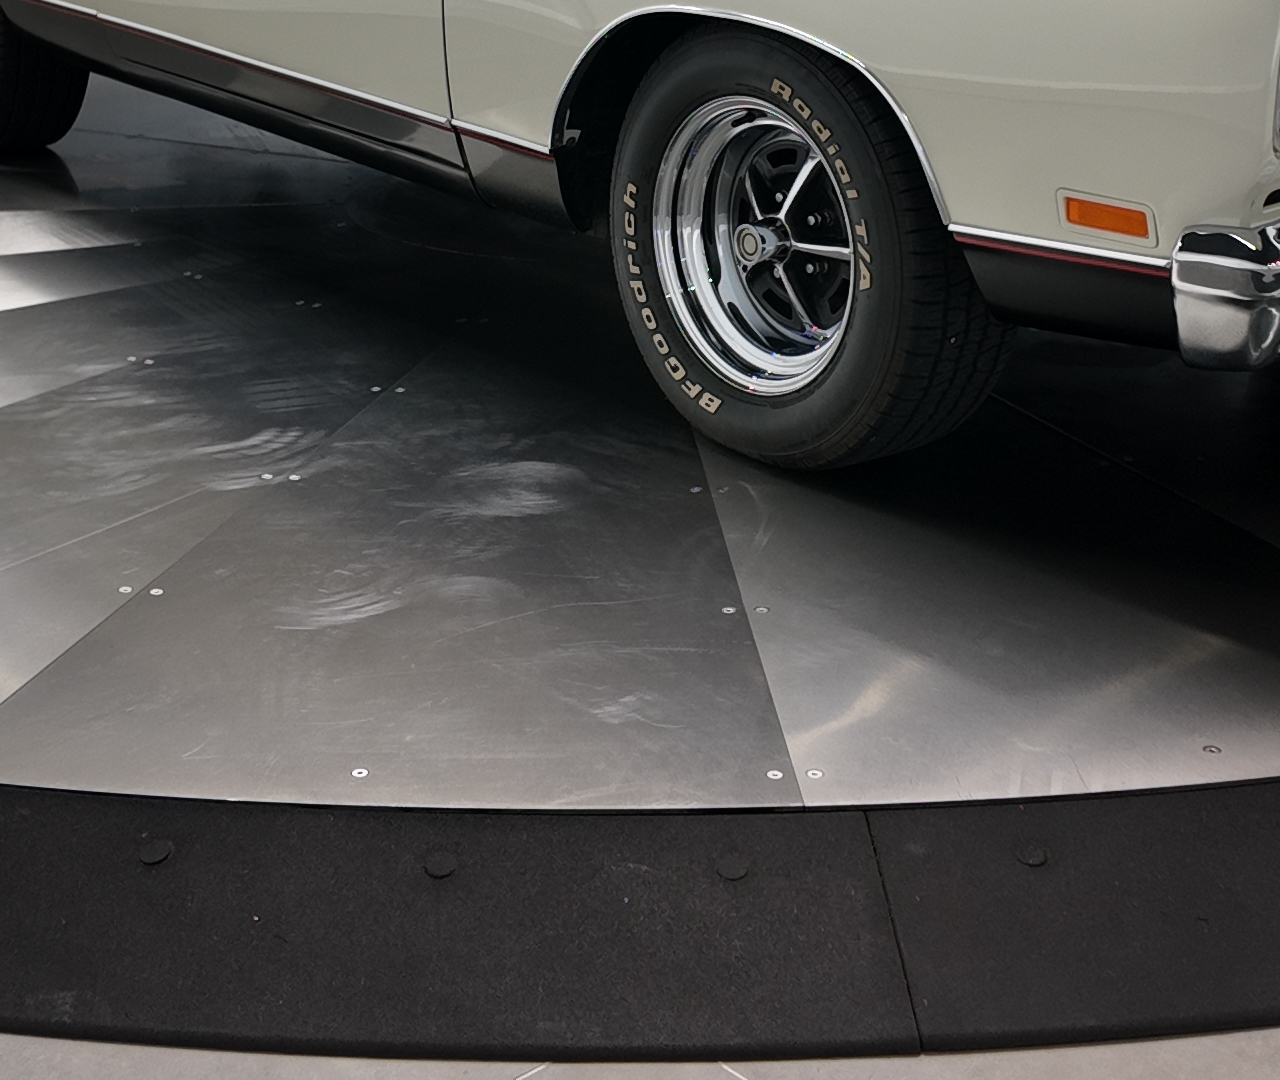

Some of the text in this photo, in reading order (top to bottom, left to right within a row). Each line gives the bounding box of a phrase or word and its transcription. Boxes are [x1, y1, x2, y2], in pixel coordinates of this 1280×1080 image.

[770, 78, 873, 291] Radial T/A
[622, 182, 722, 414] BFGoodrich
